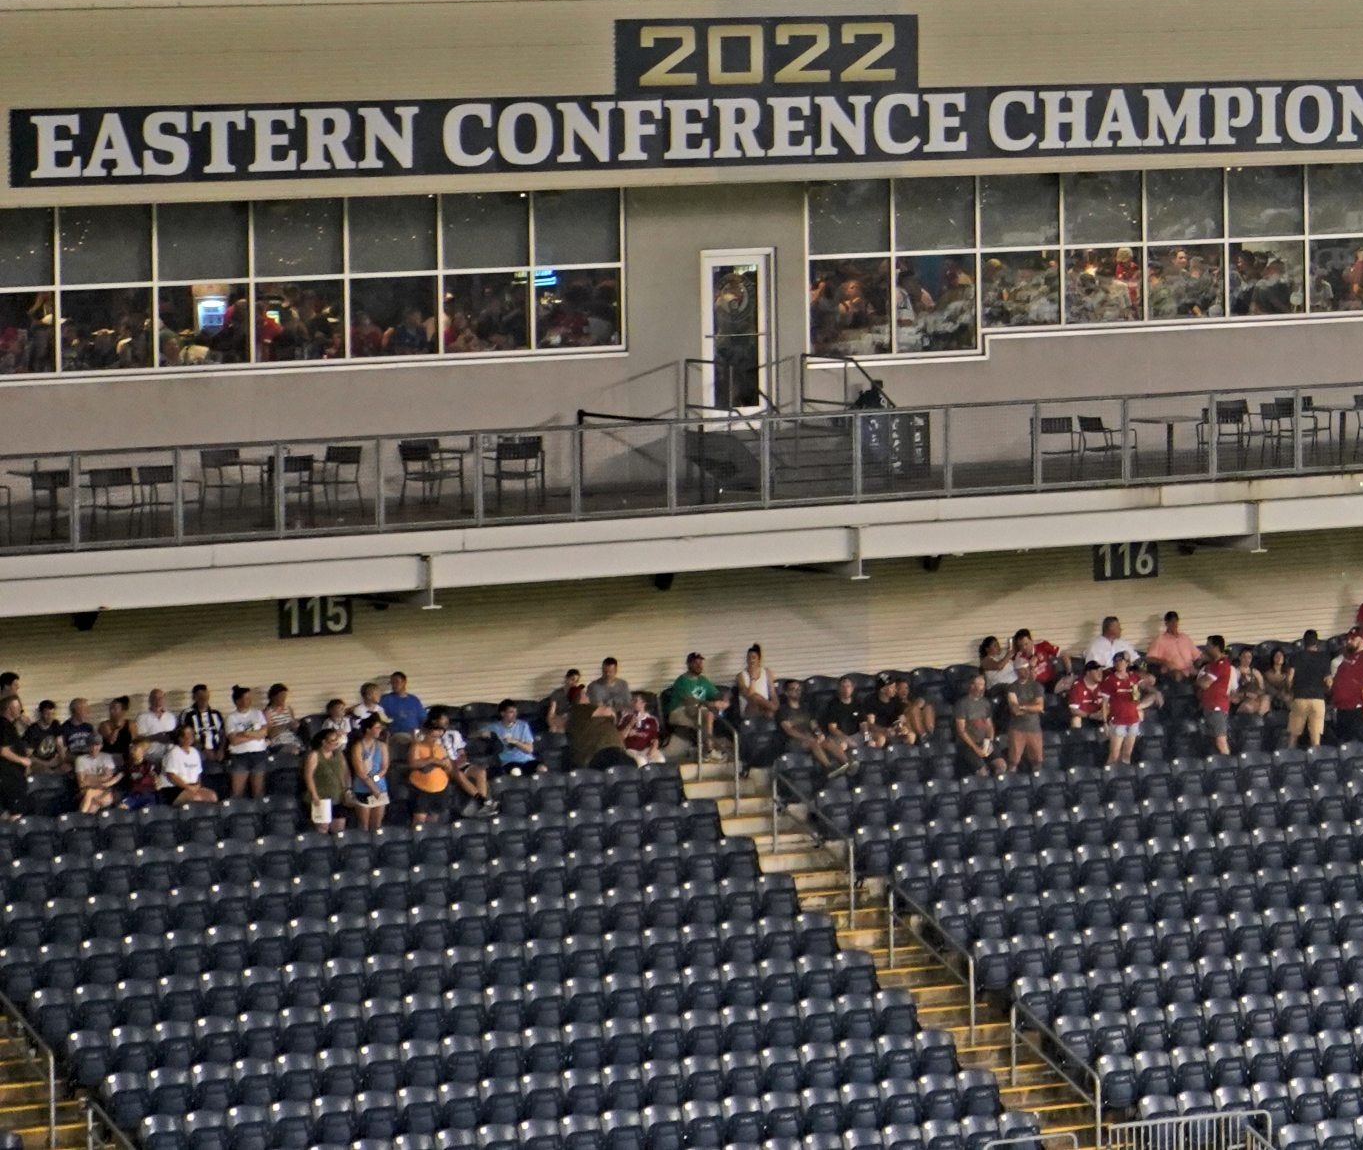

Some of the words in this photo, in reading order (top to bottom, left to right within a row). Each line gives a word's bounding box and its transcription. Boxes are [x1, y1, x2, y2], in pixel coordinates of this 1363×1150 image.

[639, 22, 896, 87] 2022
[29, 105, 420, 180] EASTERN
[442, 92, 969, 168] CONFERENCE
[1098, 541, 1155, 578] 116
[283, 597, 349, 635] 115
